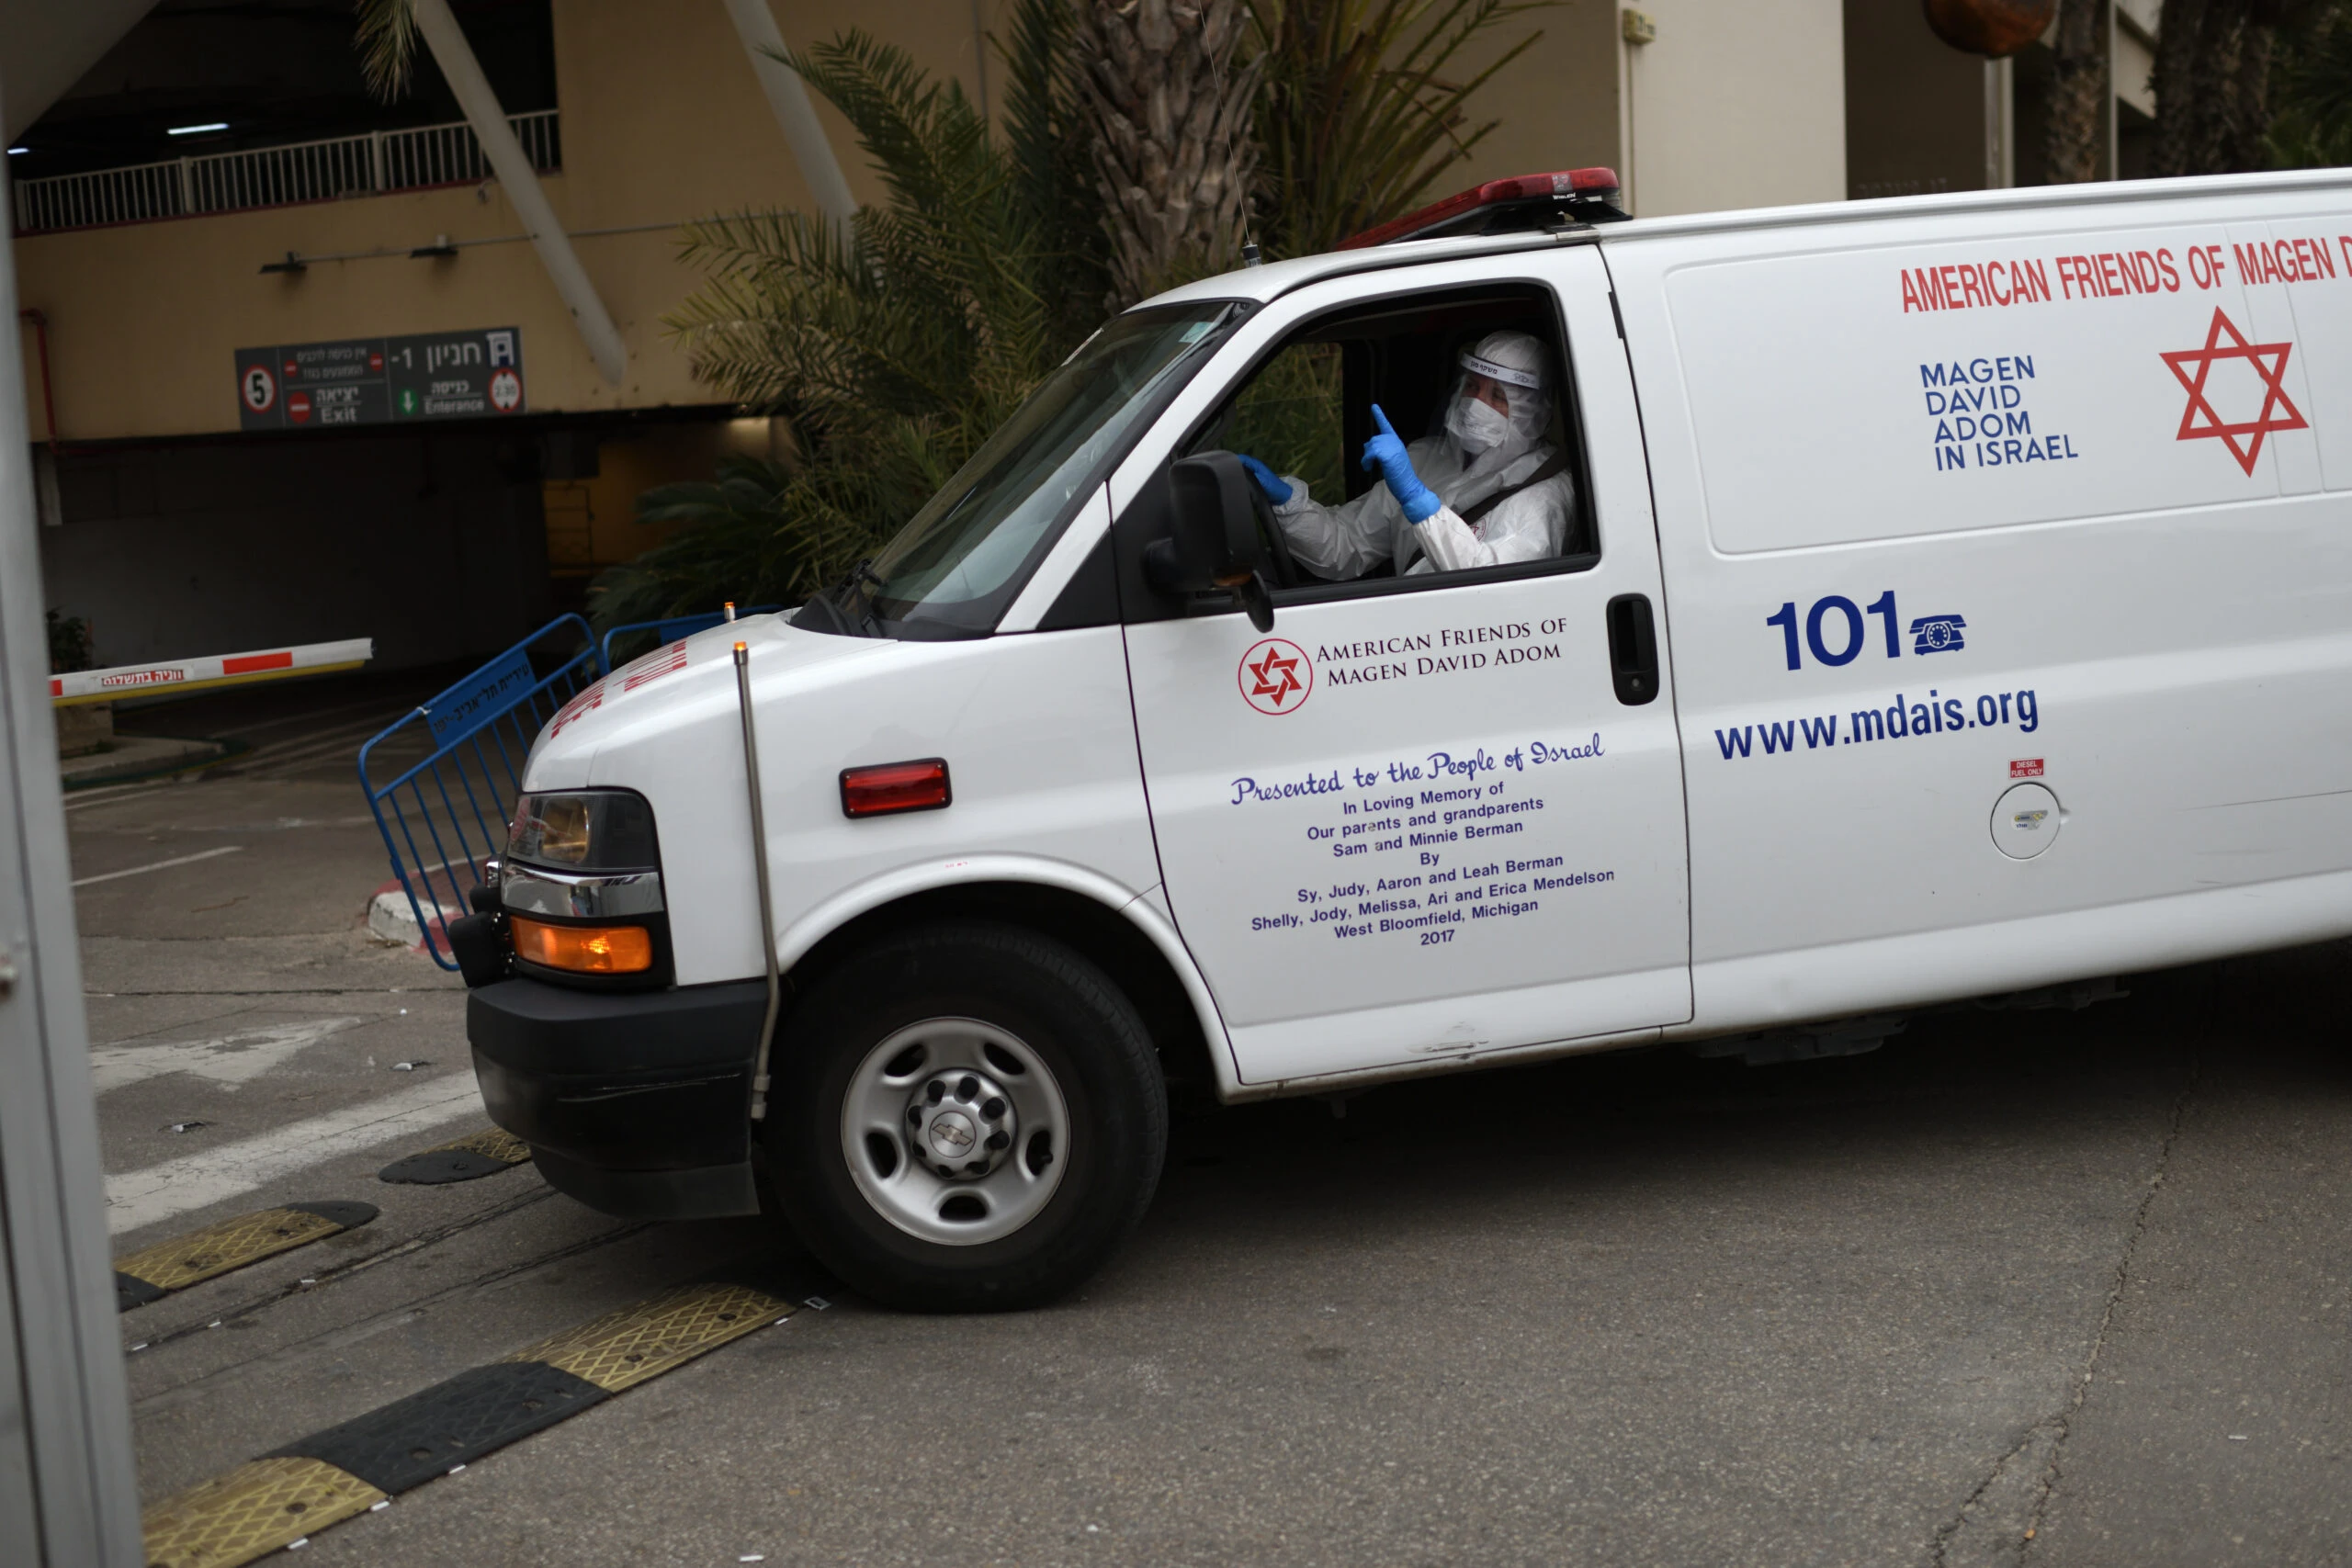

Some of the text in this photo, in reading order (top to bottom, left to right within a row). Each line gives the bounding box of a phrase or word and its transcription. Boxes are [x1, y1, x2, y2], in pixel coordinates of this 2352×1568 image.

[1901, 259, 2052, 313] AMERICAN
[2055, 247, 2181, 300] FRIENDS
[2188, 245, 2225, 290] OF
[2233, 237, 2336, 286] MAGEN
[426, 341, 481, 374] חניון
[1920, 355, 2035, 389] MAGEN
[251, 373, 266, 405] 5
[316, 386, 359, 402] יציאה
[430, 379, 470, 395] כניסה
[1926, 385, 2020, 416] DAVID
[321, 406, 357, 424] Exit
[424, 399, 485, 415] Enterance
[1934, 411, 2031, 444] ADOM
[1935, 434, 2079, 471] IN ISRAEL
[1767, 590, 1901, 671] 101
[498, 662, 530, 692] עיריית
[1714, 689, 2039, 760] www.mdais.org
[1231, 732, 1605, 805] Presented to the People of Israel
[2011, 767, 2043, 778] FUEL ONLY
[2017, 761, 2038, 769] DIESEL
[1343, 781, 1504, 815] In Loving Memory of
[1307, 798, 1544, 840] Our parents and grandparents
[1333, 822, 1522, 857] Sam and Minnie Berman
[1420, 852, 1440, 868] By
[1298, 856, 1563, 904] Sy, Judy, Aaron and Leah Berman
[1251, 871, 1614, 931] Shelly, Jody, Melissa, Ari and Erica Mendelson
[1334, 901, 1538, 939] West Bloomfield, Michigan
[1420, 929, 1455, 945] 2017
